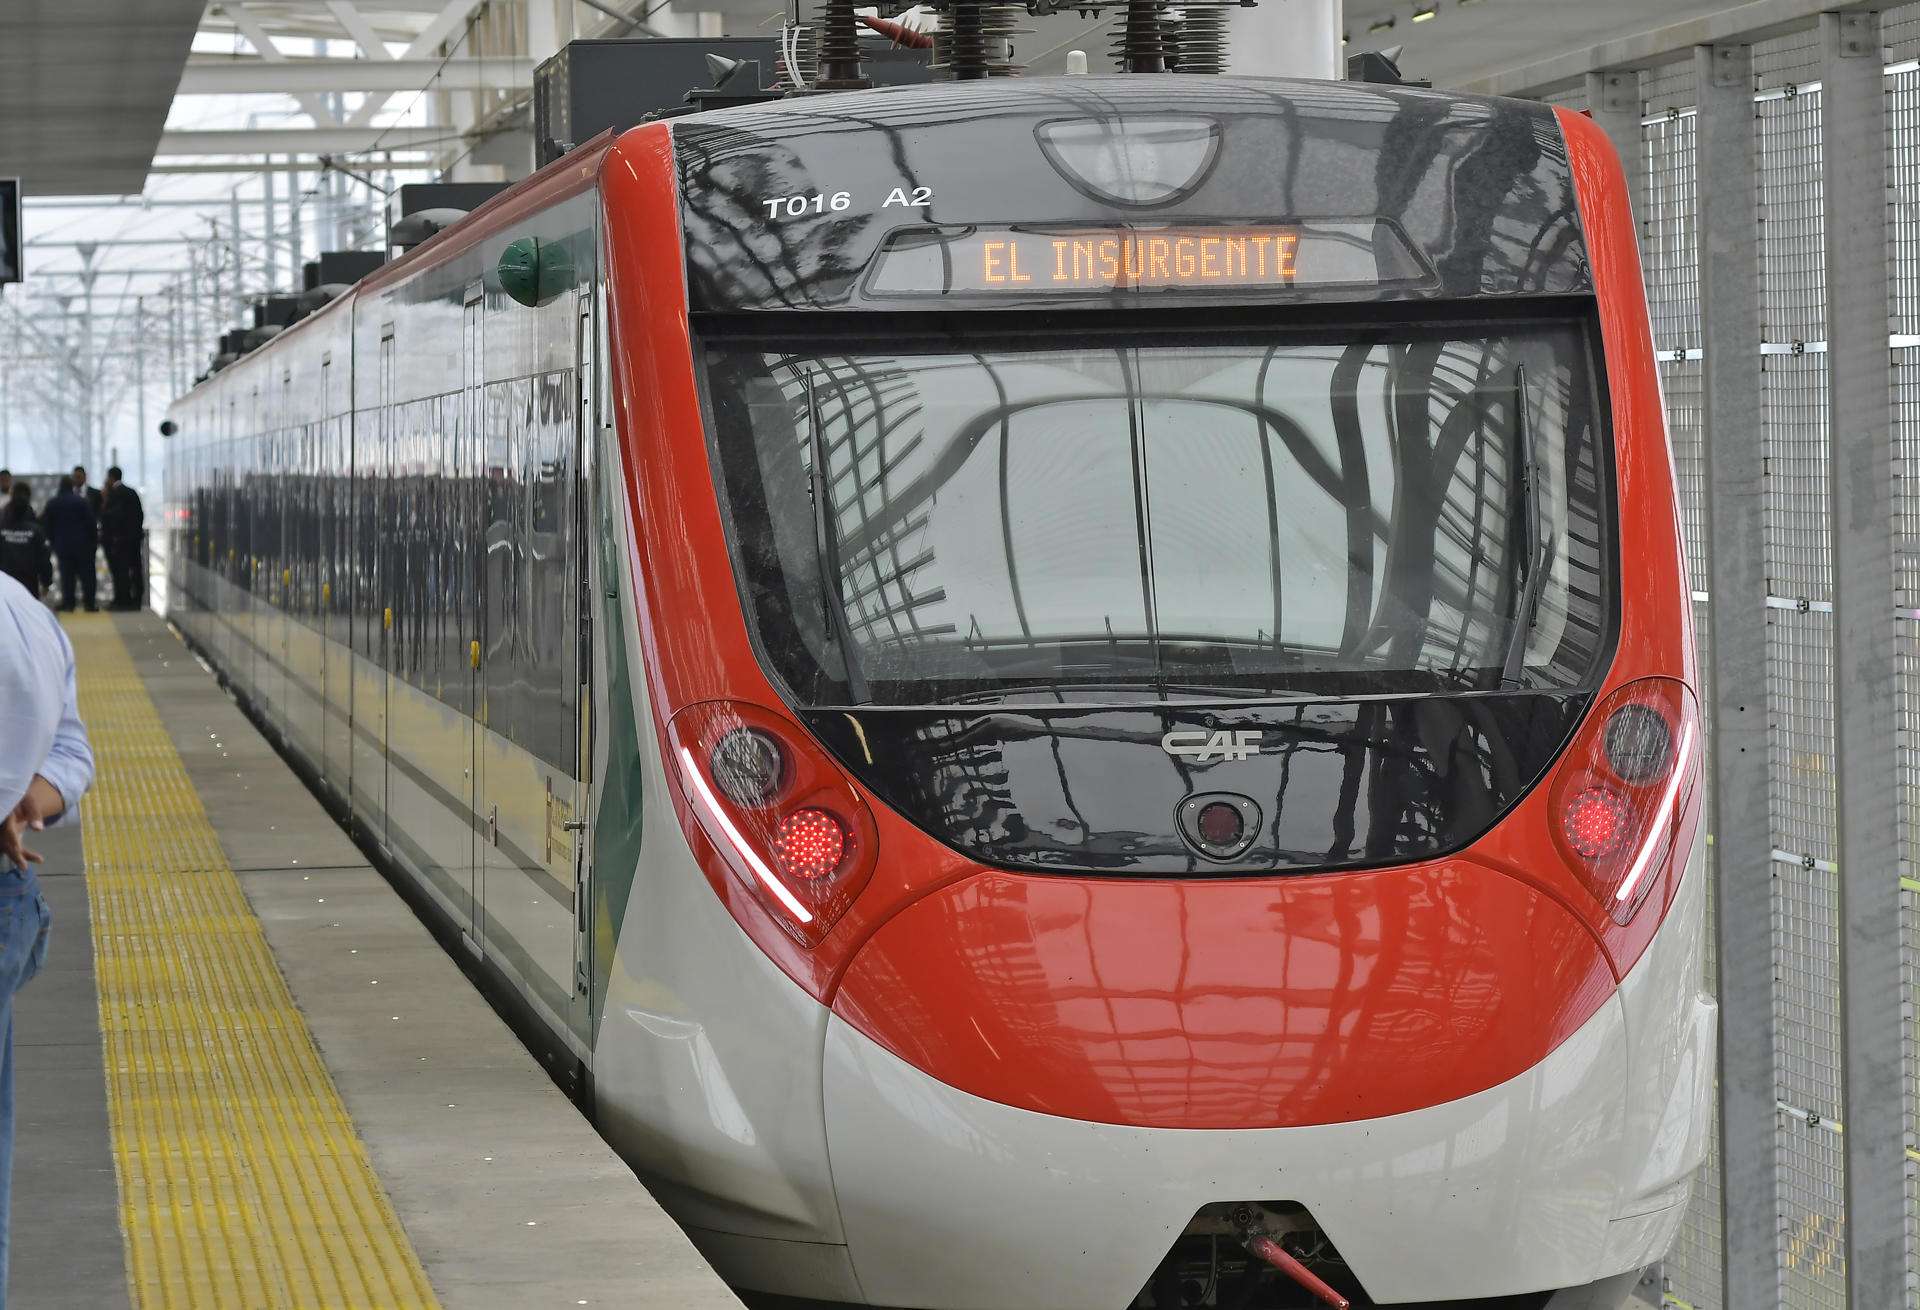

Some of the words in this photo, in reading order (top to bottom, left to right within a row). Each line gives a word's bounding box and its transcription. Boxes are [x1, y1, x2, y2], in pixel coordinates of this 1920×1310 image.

[762, 191, 851, 219] T016
[881, 186, 932, 208] A2
[984, 239, 1031, 281] EL
[1052, 235, 1297, 280] INSURGENTE
[1161, 730, 1263, 761] CAF
